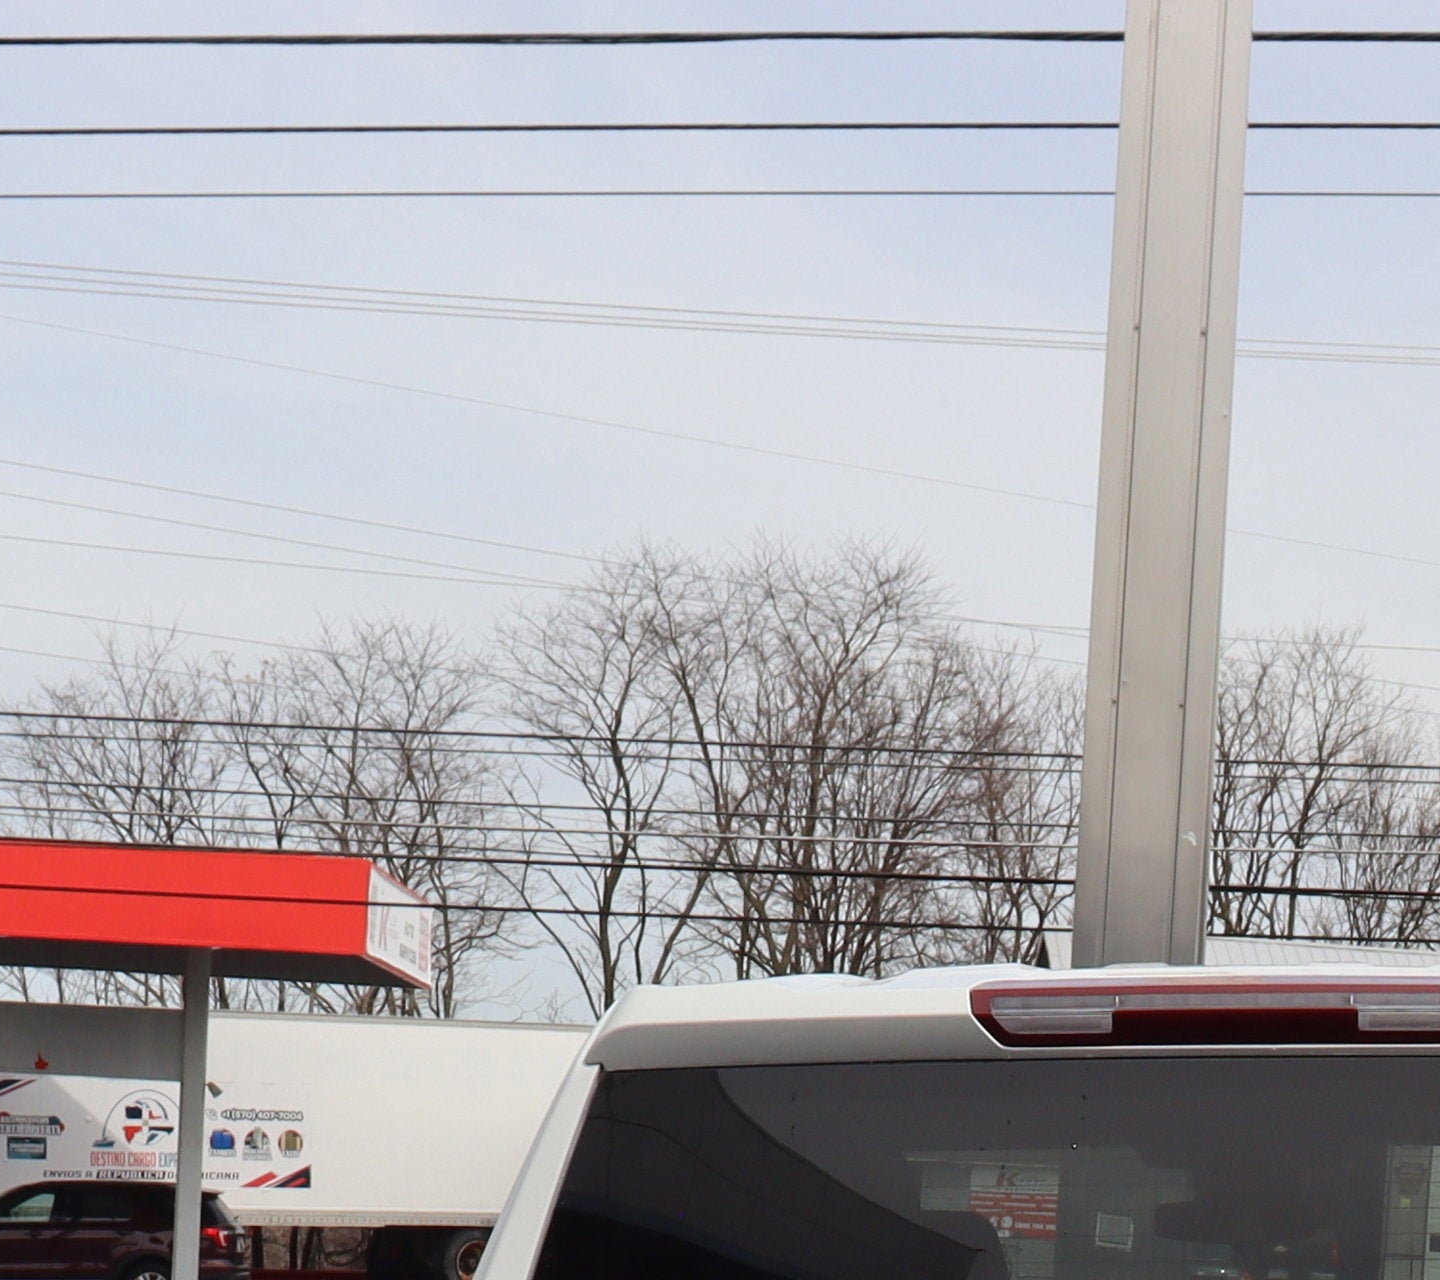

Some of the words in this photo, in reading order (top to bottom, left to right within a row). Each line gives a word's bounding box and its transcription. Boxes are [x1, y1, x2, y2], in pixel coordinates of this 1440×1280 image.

[231, 1108, 256, 1122] (570)
[91, 1151, 126, 1167] DESTINO
[128, 1152, 156, 1167] CARGO
[43, 1170, 82, 1178] ENVIOS
